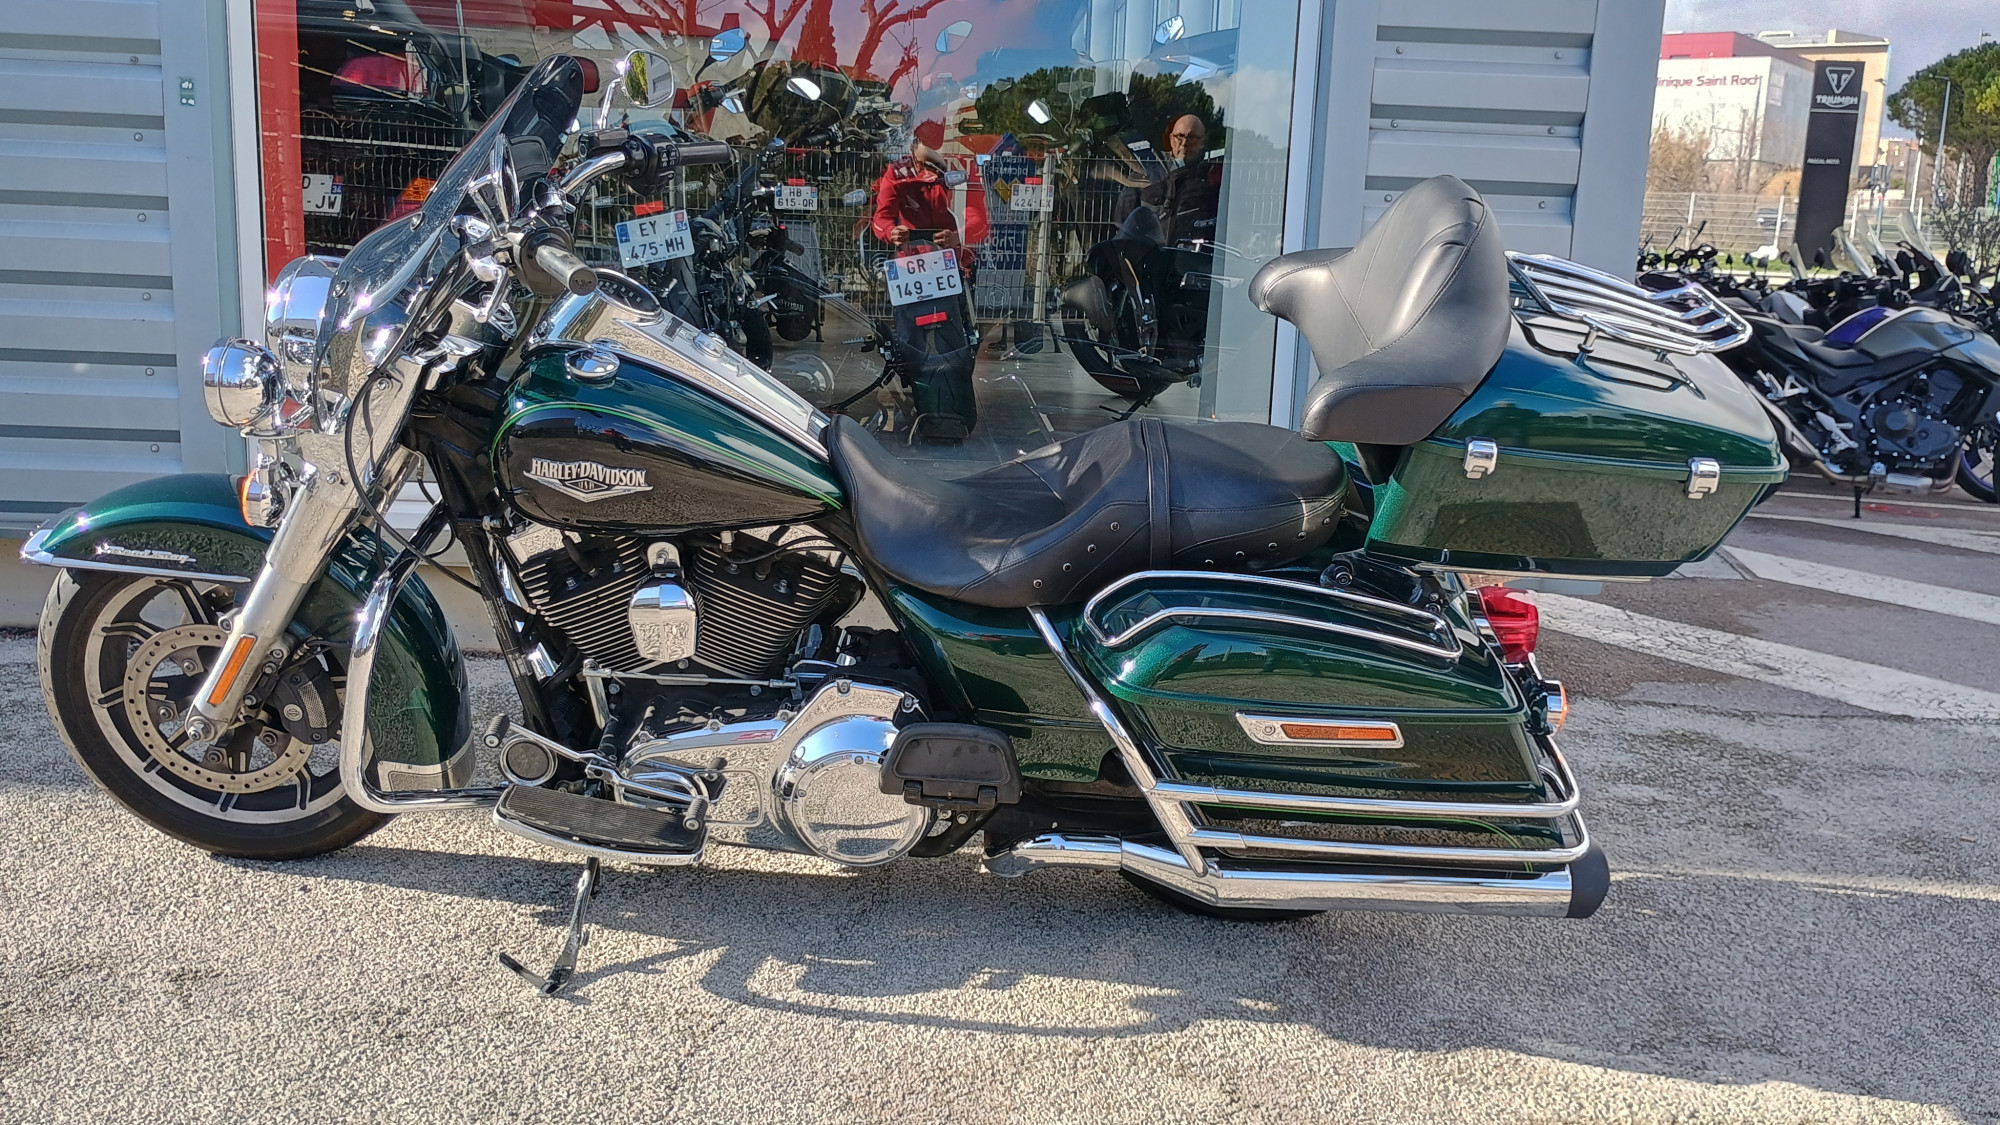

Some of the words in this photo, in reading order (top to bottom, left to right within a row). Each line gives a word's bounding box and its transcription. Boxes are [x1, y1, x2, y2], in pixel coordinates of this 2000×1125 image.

[1696, 75, 1727, 86] Saint
[1816, 94, 1858, 105] TRIUMPH
[789, 188, 802, 197] HB
[778, 198, 814, 208] 615-QR
[639, 220, 657, 237] EY
[630, 236, 686, 260] 475-MH
[906, 258, 927, 275] GR
[944, 260, 955, 269] 34
[895, 275, 957, 299] 149-EC
